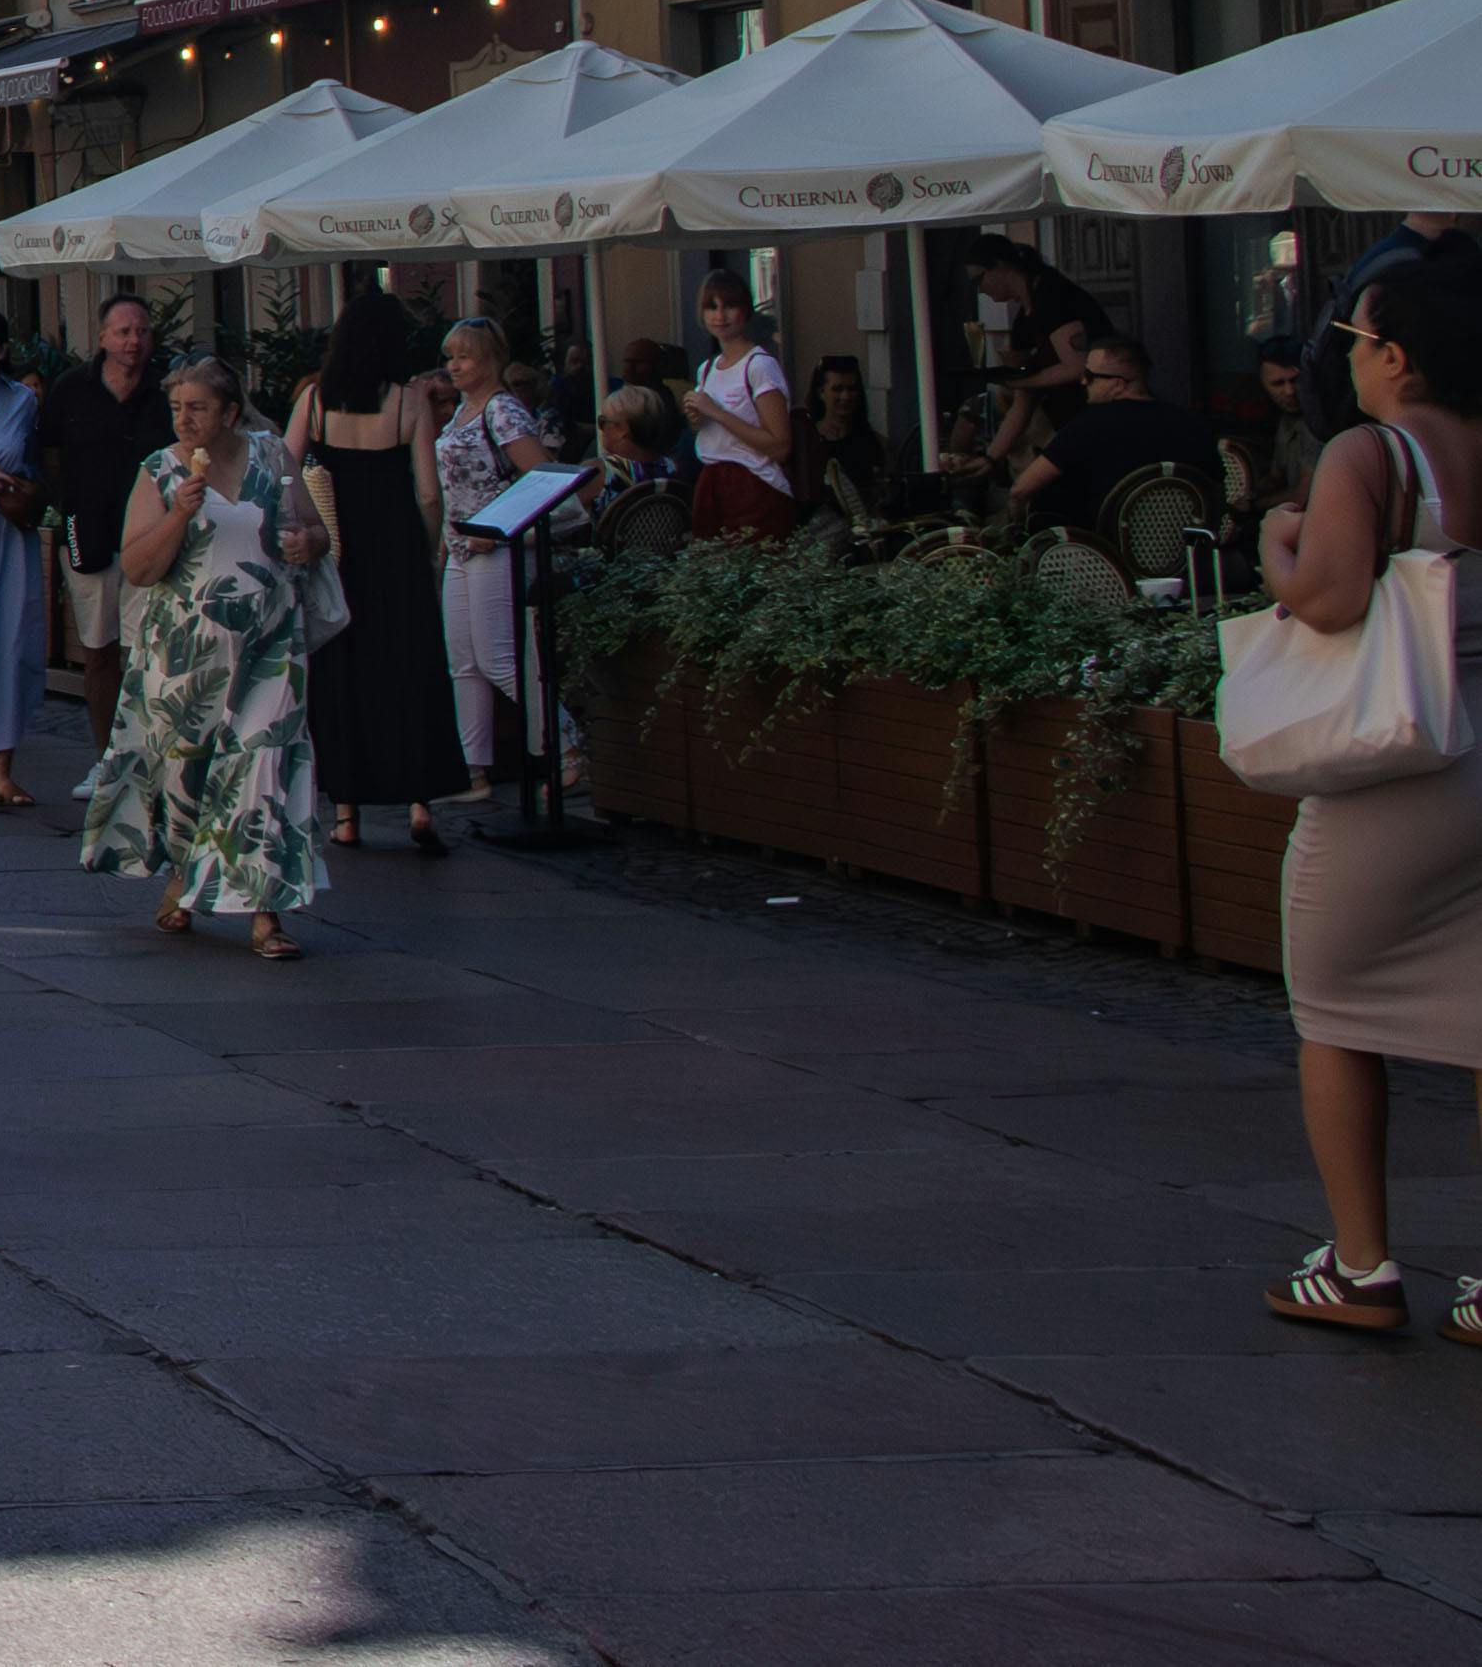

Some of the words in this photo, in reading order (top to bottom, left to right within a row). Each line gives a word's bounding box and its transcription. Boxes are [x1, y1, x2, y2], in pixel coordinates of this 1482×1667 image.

[1086, 153, 1155, 185] CUKIERNIA
[1188, 154, 1235, 185] SOWA
[738, 186, 858, 209] CUKIERNIA
[912, 176, 972, 199] SOWA
[319, 215, 402, 234] CUKIERNIA
[490, 204, 550, 226] CUKIERNIA
